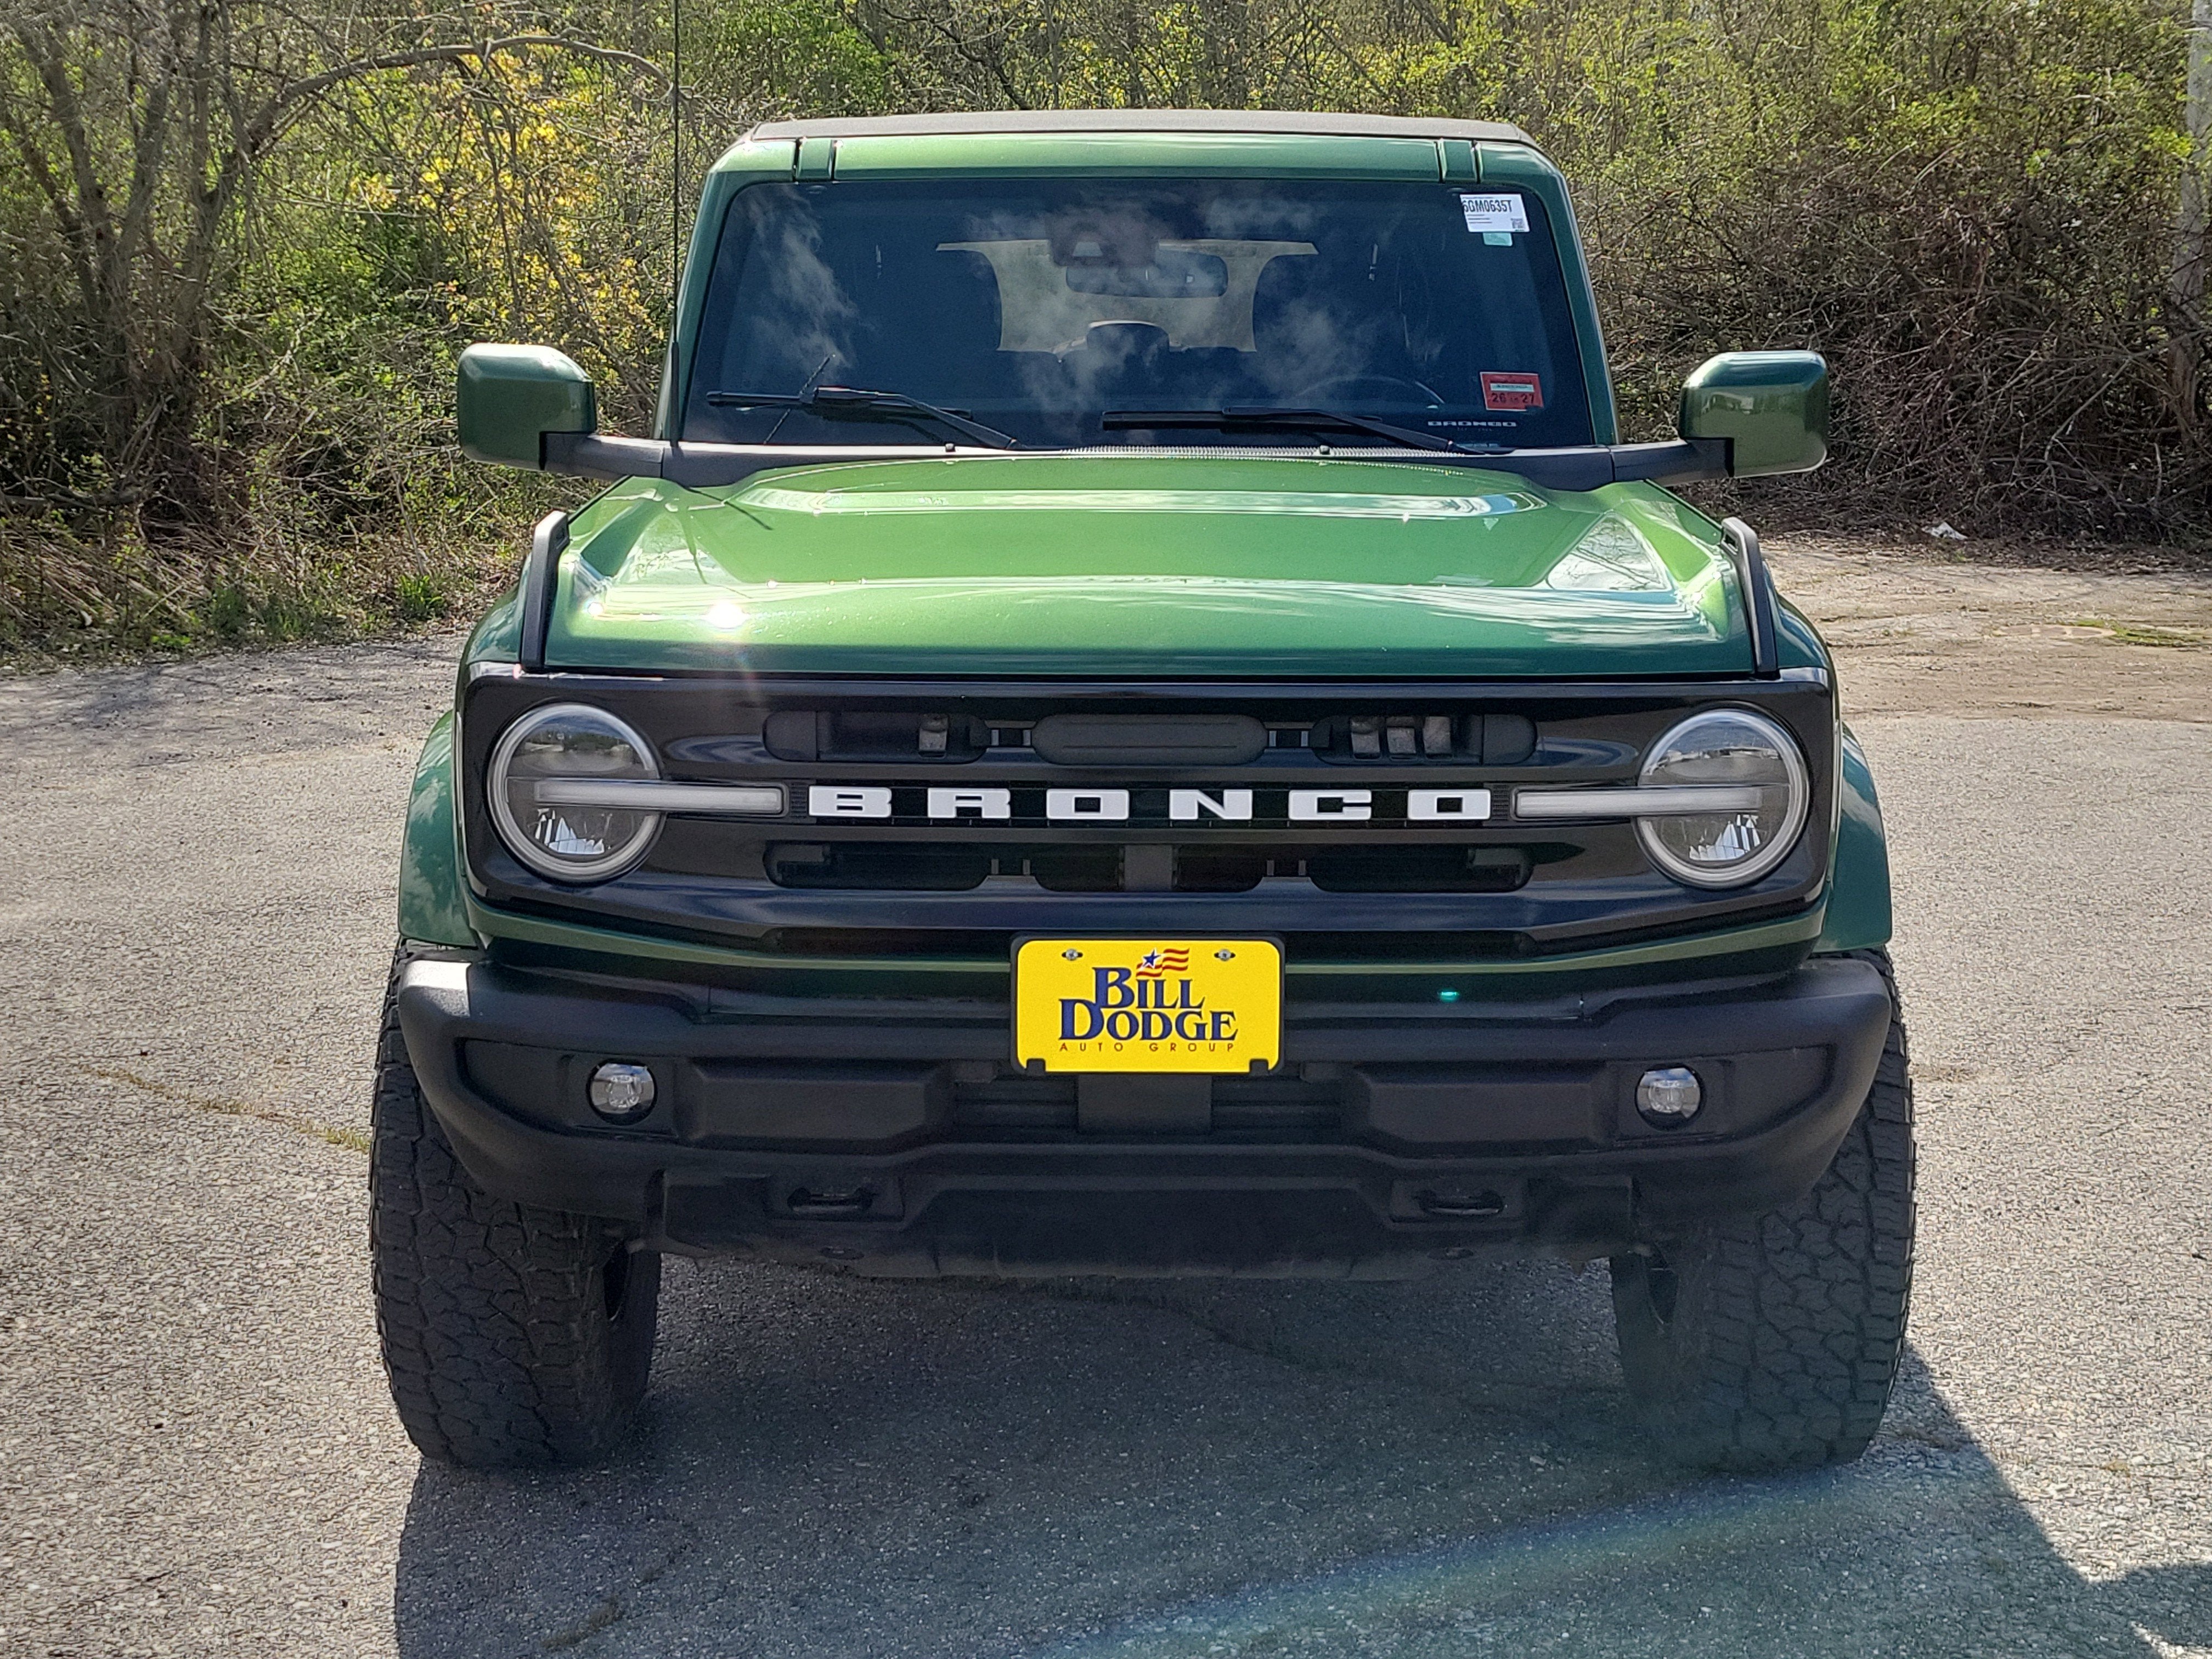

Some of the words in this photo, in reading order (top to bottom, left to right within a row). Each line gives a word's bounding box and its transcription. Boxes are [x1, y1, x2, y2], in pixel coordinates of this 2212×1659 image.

[808, 785, 1492, 821] BRONCO
[1092, 967, 1205, 1009] BILL
[1058, 998, 1238, 1041] DODGE
[1059, 1042, 1124, 1052] AUTO
[1149, 1042, 1235, 1053] GROUP
